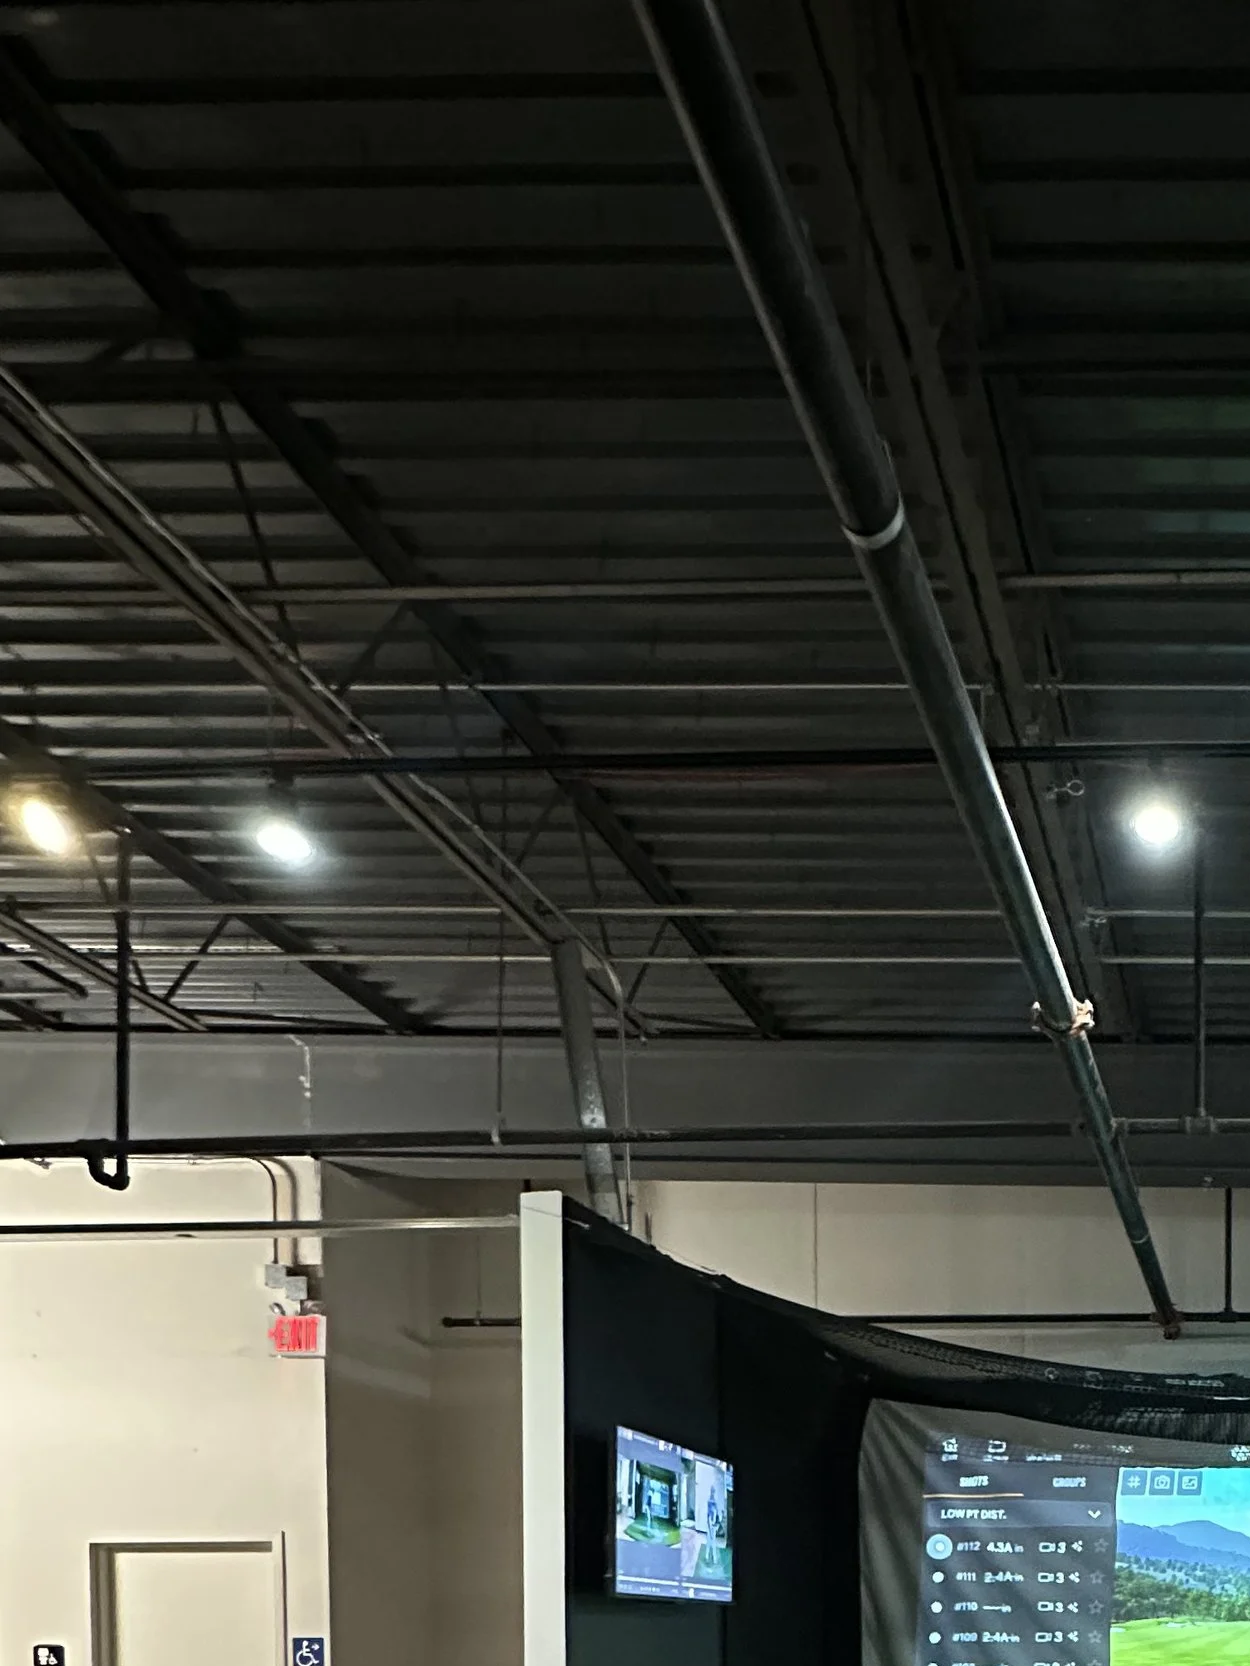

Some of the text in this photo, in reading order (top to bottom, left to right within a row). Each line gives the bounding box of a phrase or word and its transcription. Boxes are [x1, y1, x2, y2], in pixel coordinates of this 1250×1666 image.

[275, 1315, 319, 1352] EXIT
[941, 1509, 1007, 1520] LOW PT DIST.
